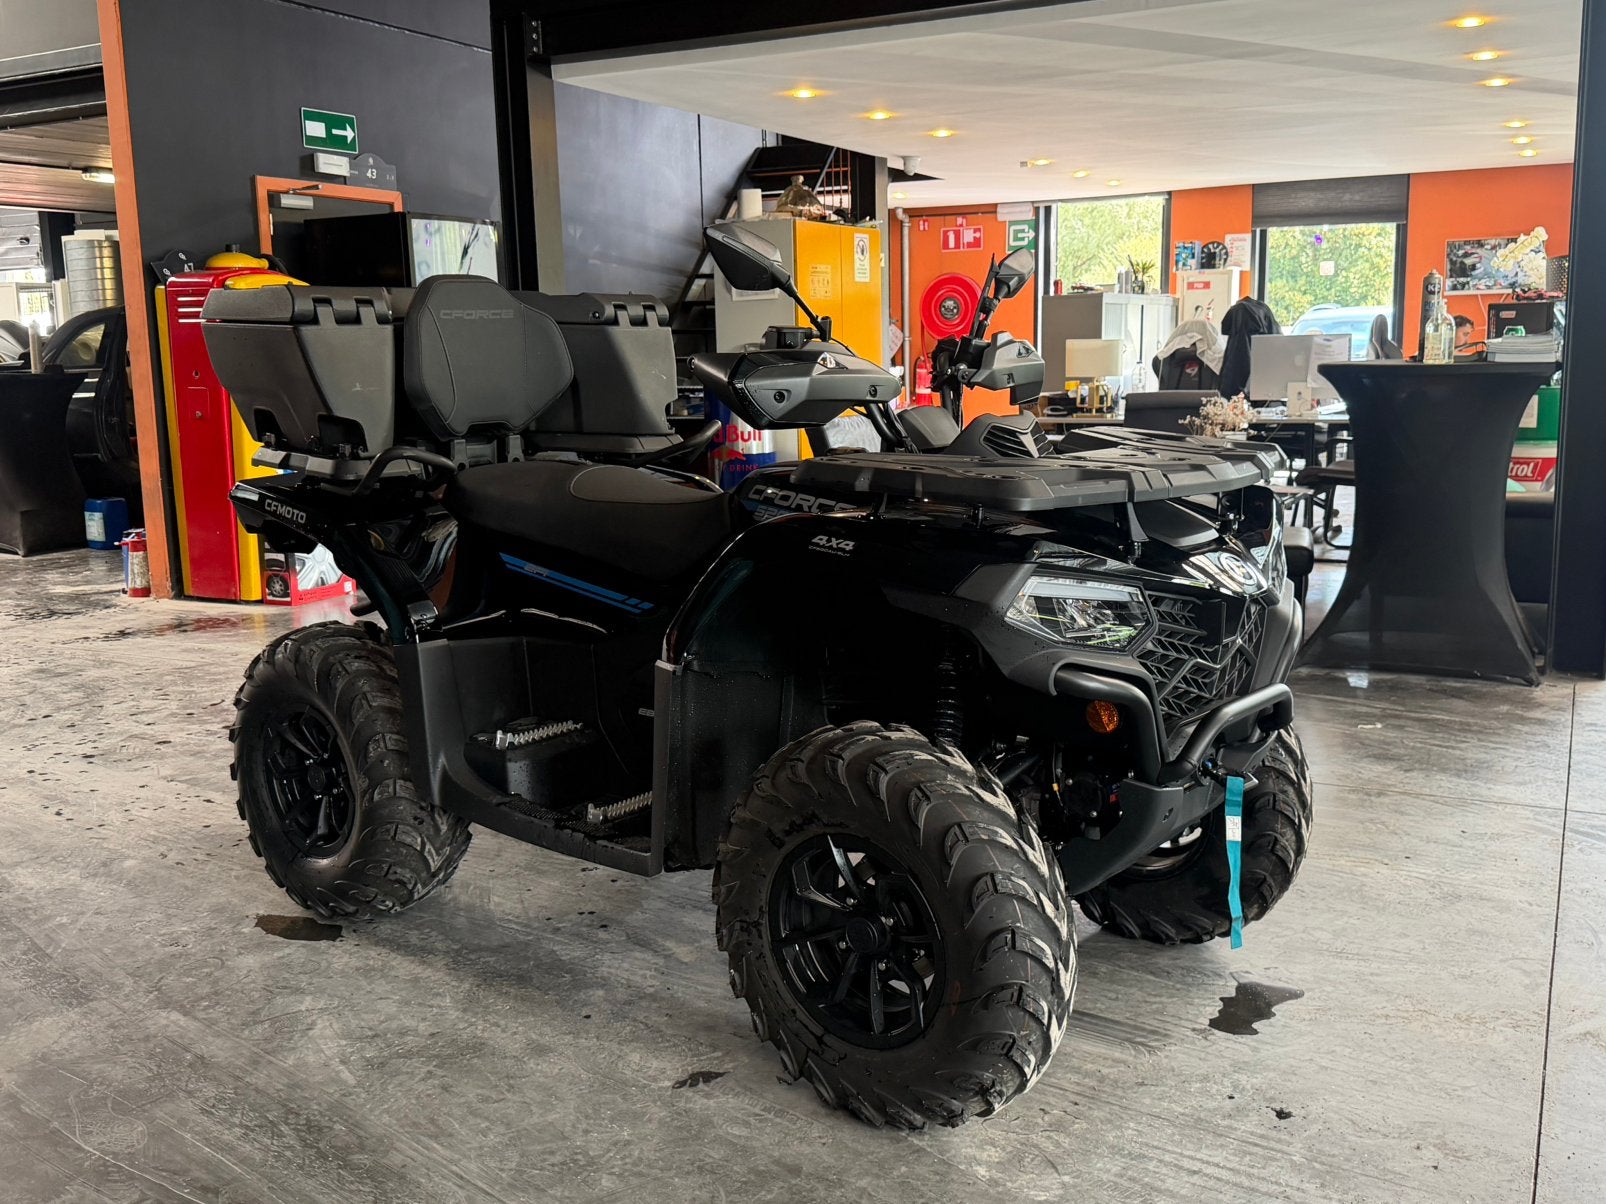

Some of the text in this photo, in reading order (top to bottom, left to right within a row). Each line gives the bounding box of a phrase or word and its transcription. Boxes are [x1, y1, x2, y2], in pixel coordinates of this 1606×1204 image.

[366, 168, 377, 179] 43
[440, 309, 514, 320] CFORCE
[1508, 461, 1535, 477] trol
[264, 498, 307, 524] CFMOTO
